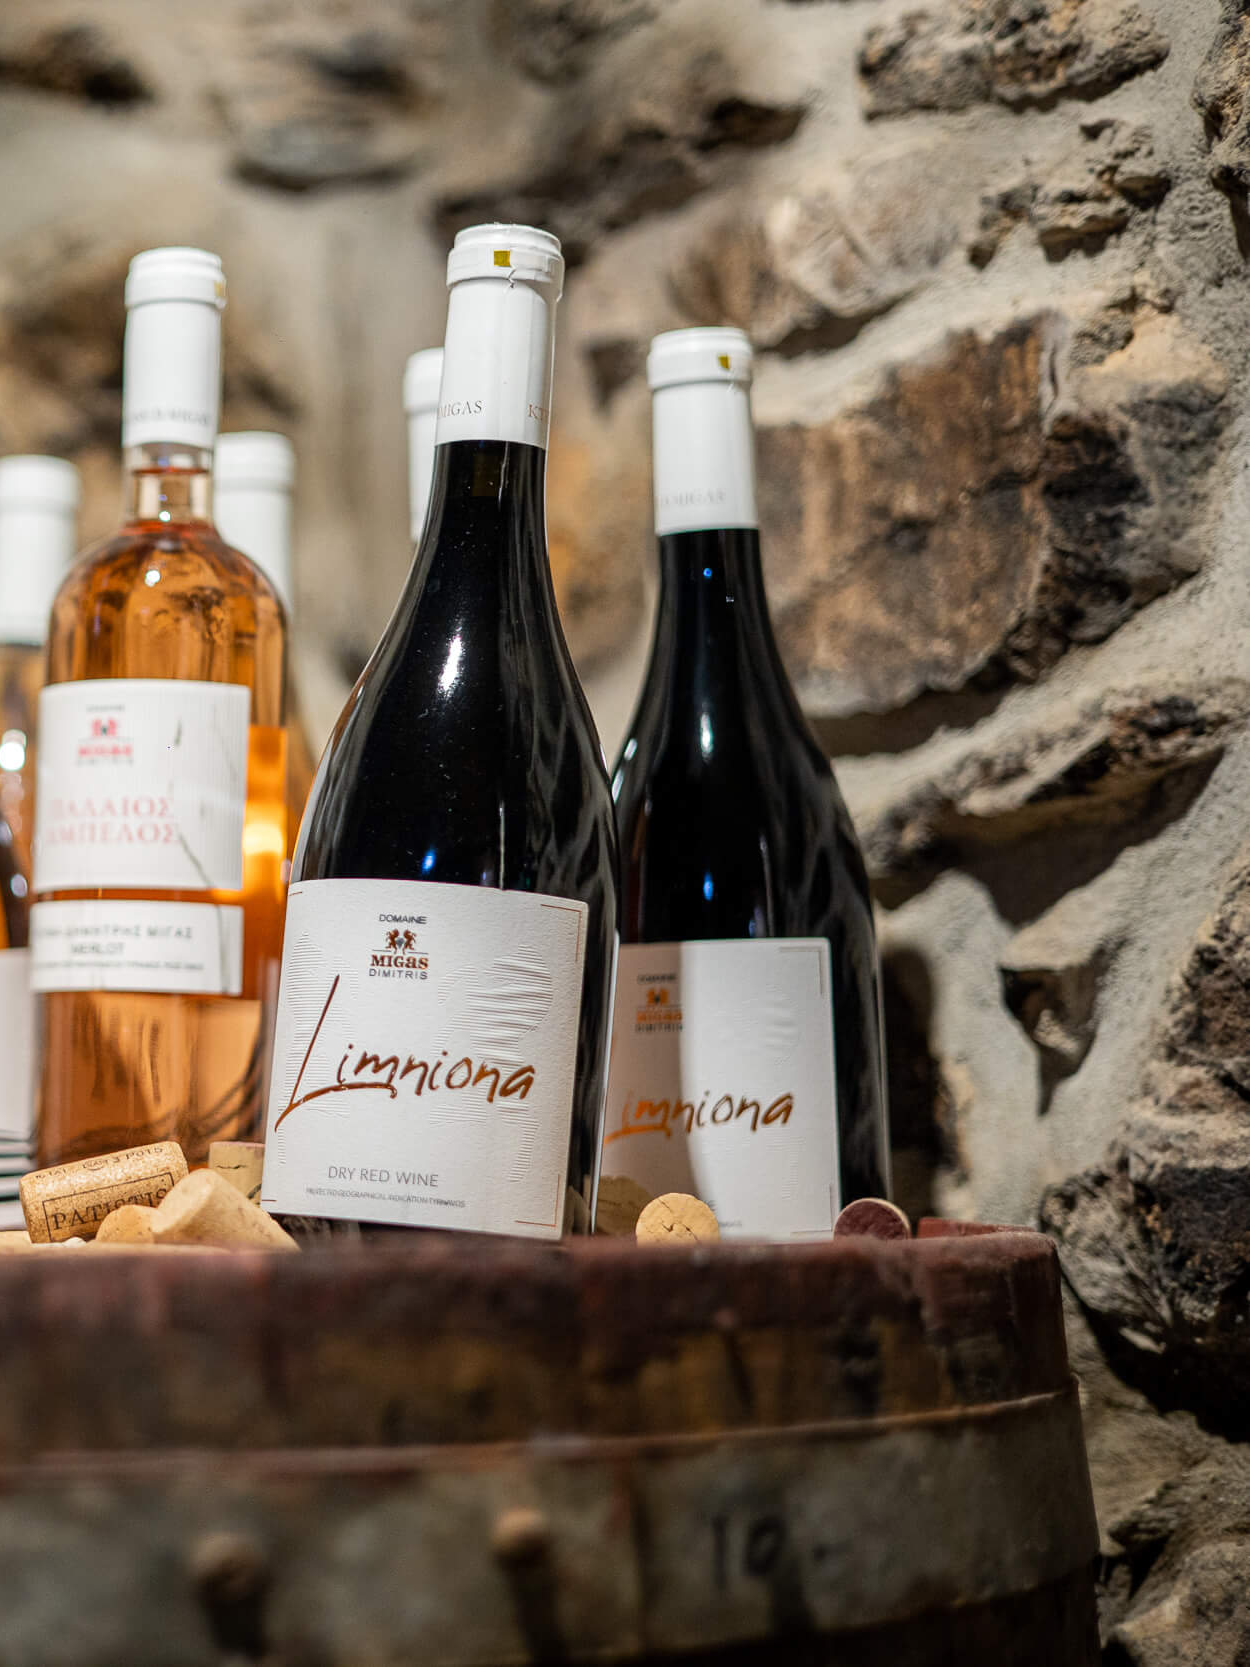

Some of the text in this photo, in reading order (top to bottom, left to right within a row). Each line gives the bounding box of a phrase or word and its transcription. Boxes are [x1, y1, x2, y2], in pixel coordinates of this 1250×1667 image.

[378, 913, 428, 925] DOMAINE
[368, 968, 429, 981] DIMITRIS
[274, 974, 536, 1133] Limniona
[603, 1089, 795, 1143] imniona
[327, 1165, 439, 1188] DRY RED WINE
